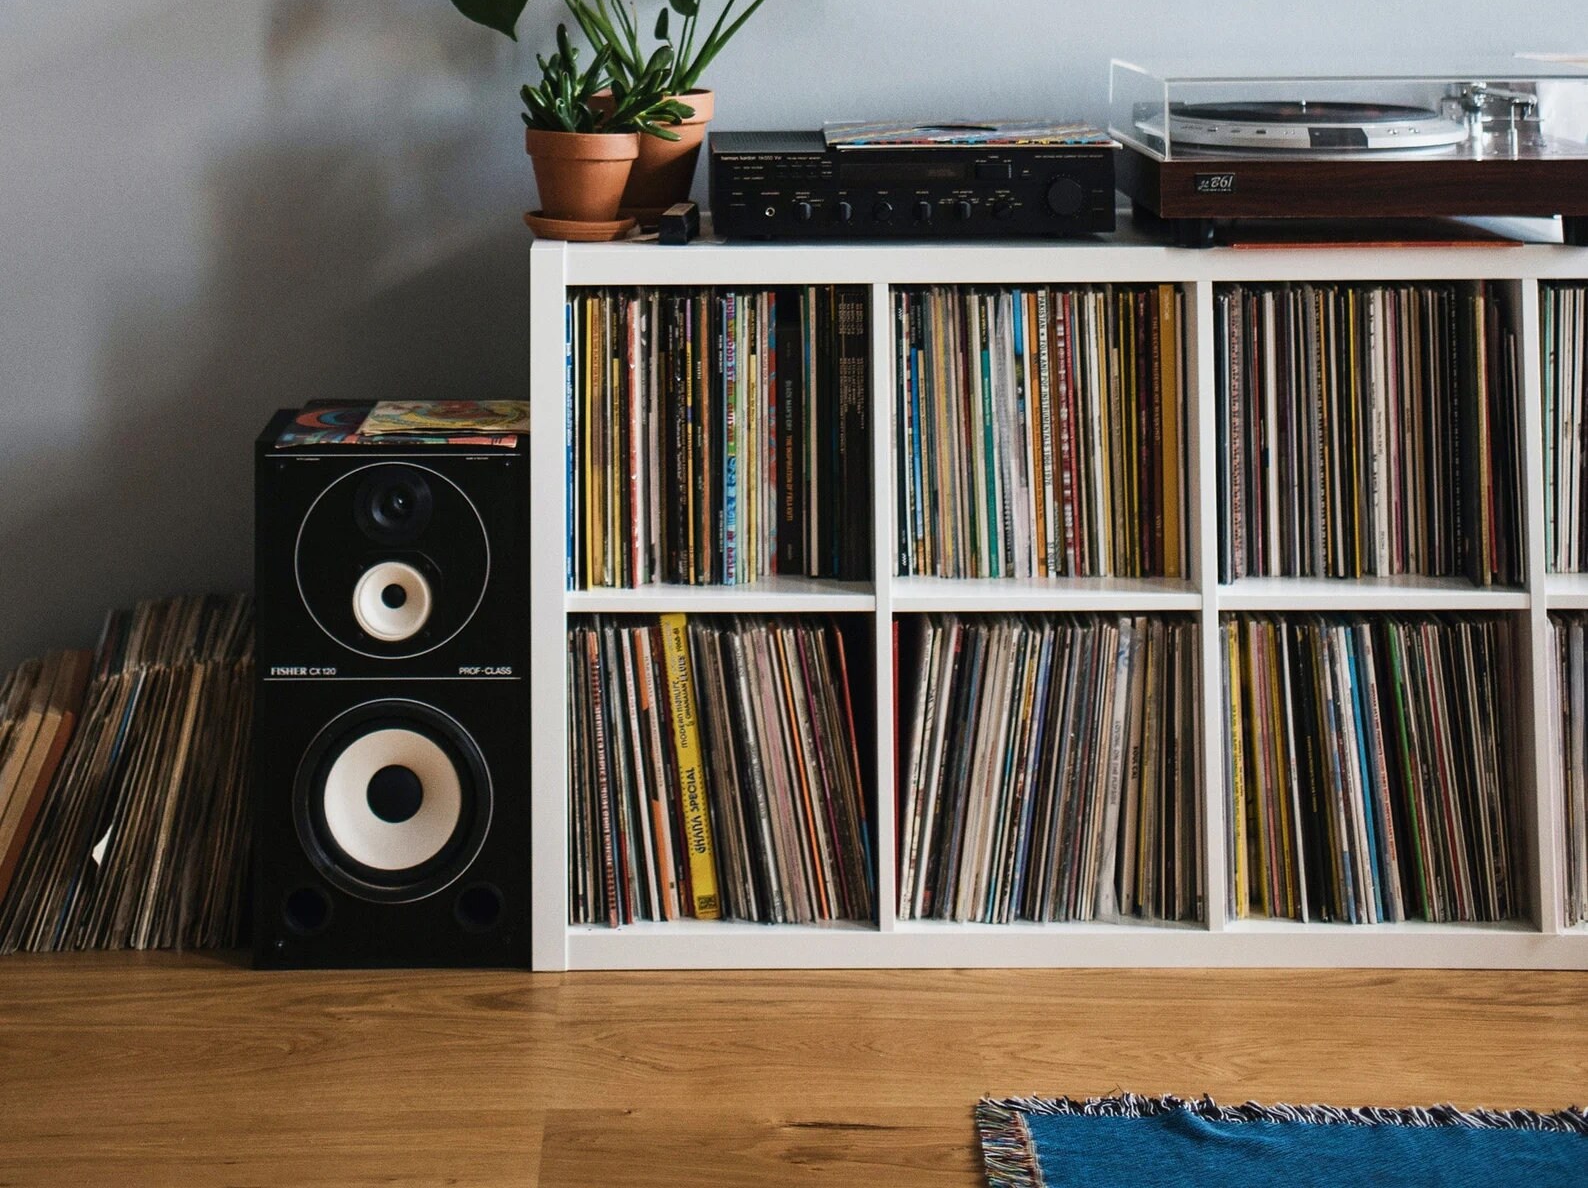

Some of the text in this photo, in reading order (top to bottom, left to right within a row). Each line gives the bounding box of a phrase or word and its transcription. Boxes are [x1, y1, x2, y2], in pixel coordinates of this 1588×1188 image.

[1038, 296, 1047, 329] PAKISTAN
[1040, 340, 1048, 357] FOLK
[1041, 359, 1049, 373] AND
[1154, 394, 1160, 403] OF
[1042, 391, 1052, 448] INSTRUMENTALS
[271, 668, 336, 676] FISHER CX 120
[678, 714, 688, 748] MODERN
[1113, 749, 1120, 761] ON
[1112, 763, 1120, 775] THE
[686, 767, 706, 854] GHANA SPECIAL
